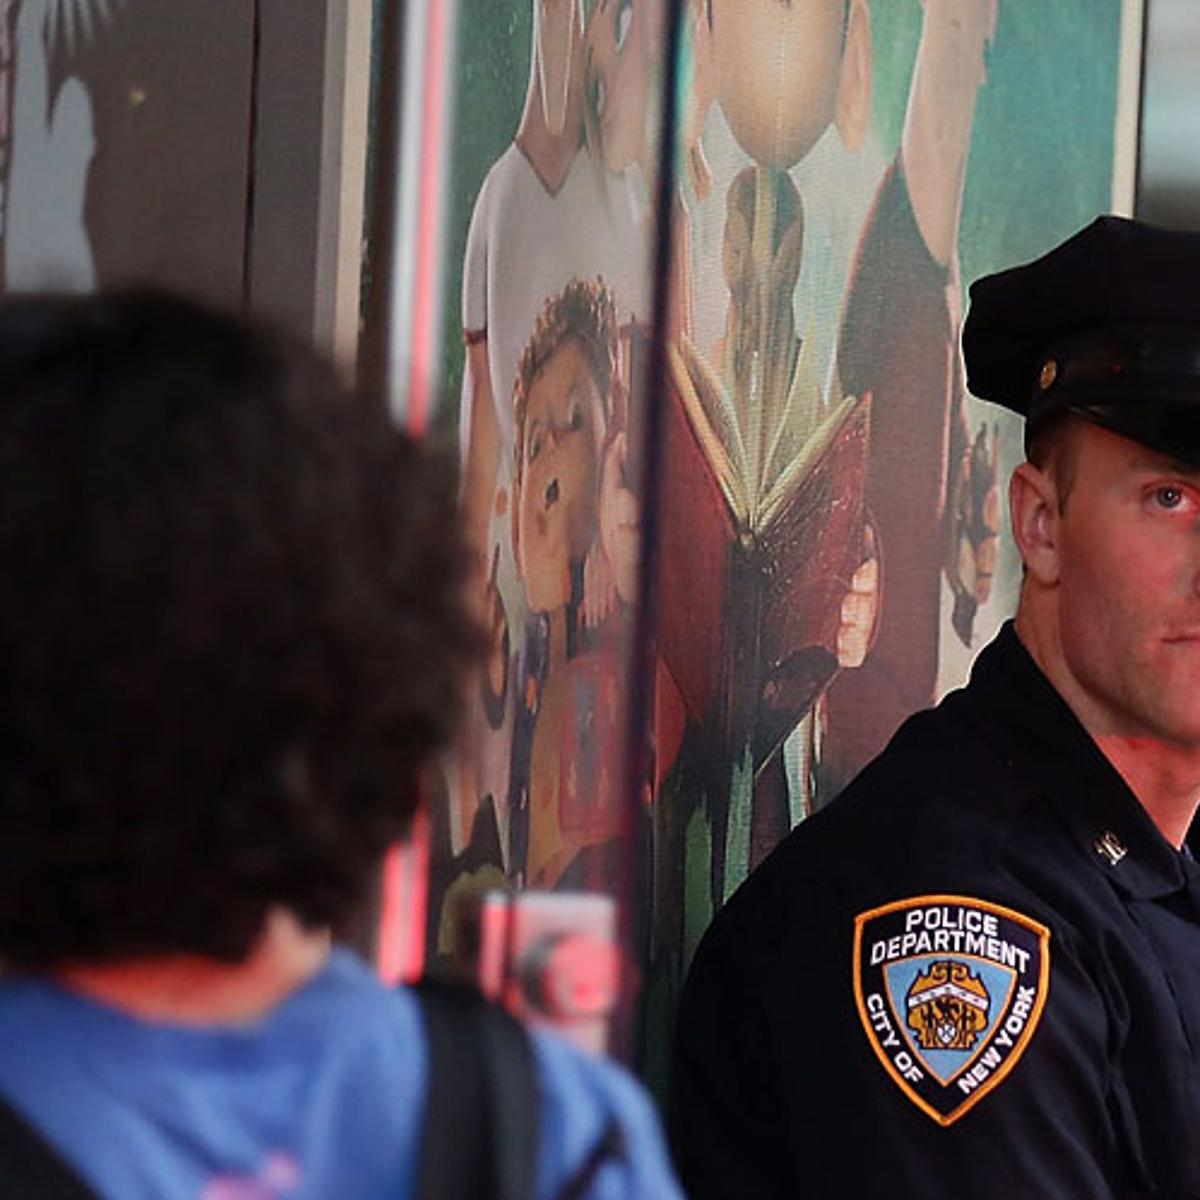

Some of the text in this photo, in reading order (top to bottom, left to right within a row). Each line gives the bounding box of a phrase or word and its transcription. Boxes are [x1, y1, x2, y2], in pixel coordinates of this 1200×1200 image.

[870, 929, 1031, 973] DEPARTMENT
[905, 907, 999, 937] POLICE
[867, 993, 924, 1083] CITY OF
[957, 985, 1035, 1094] NEW YORK
